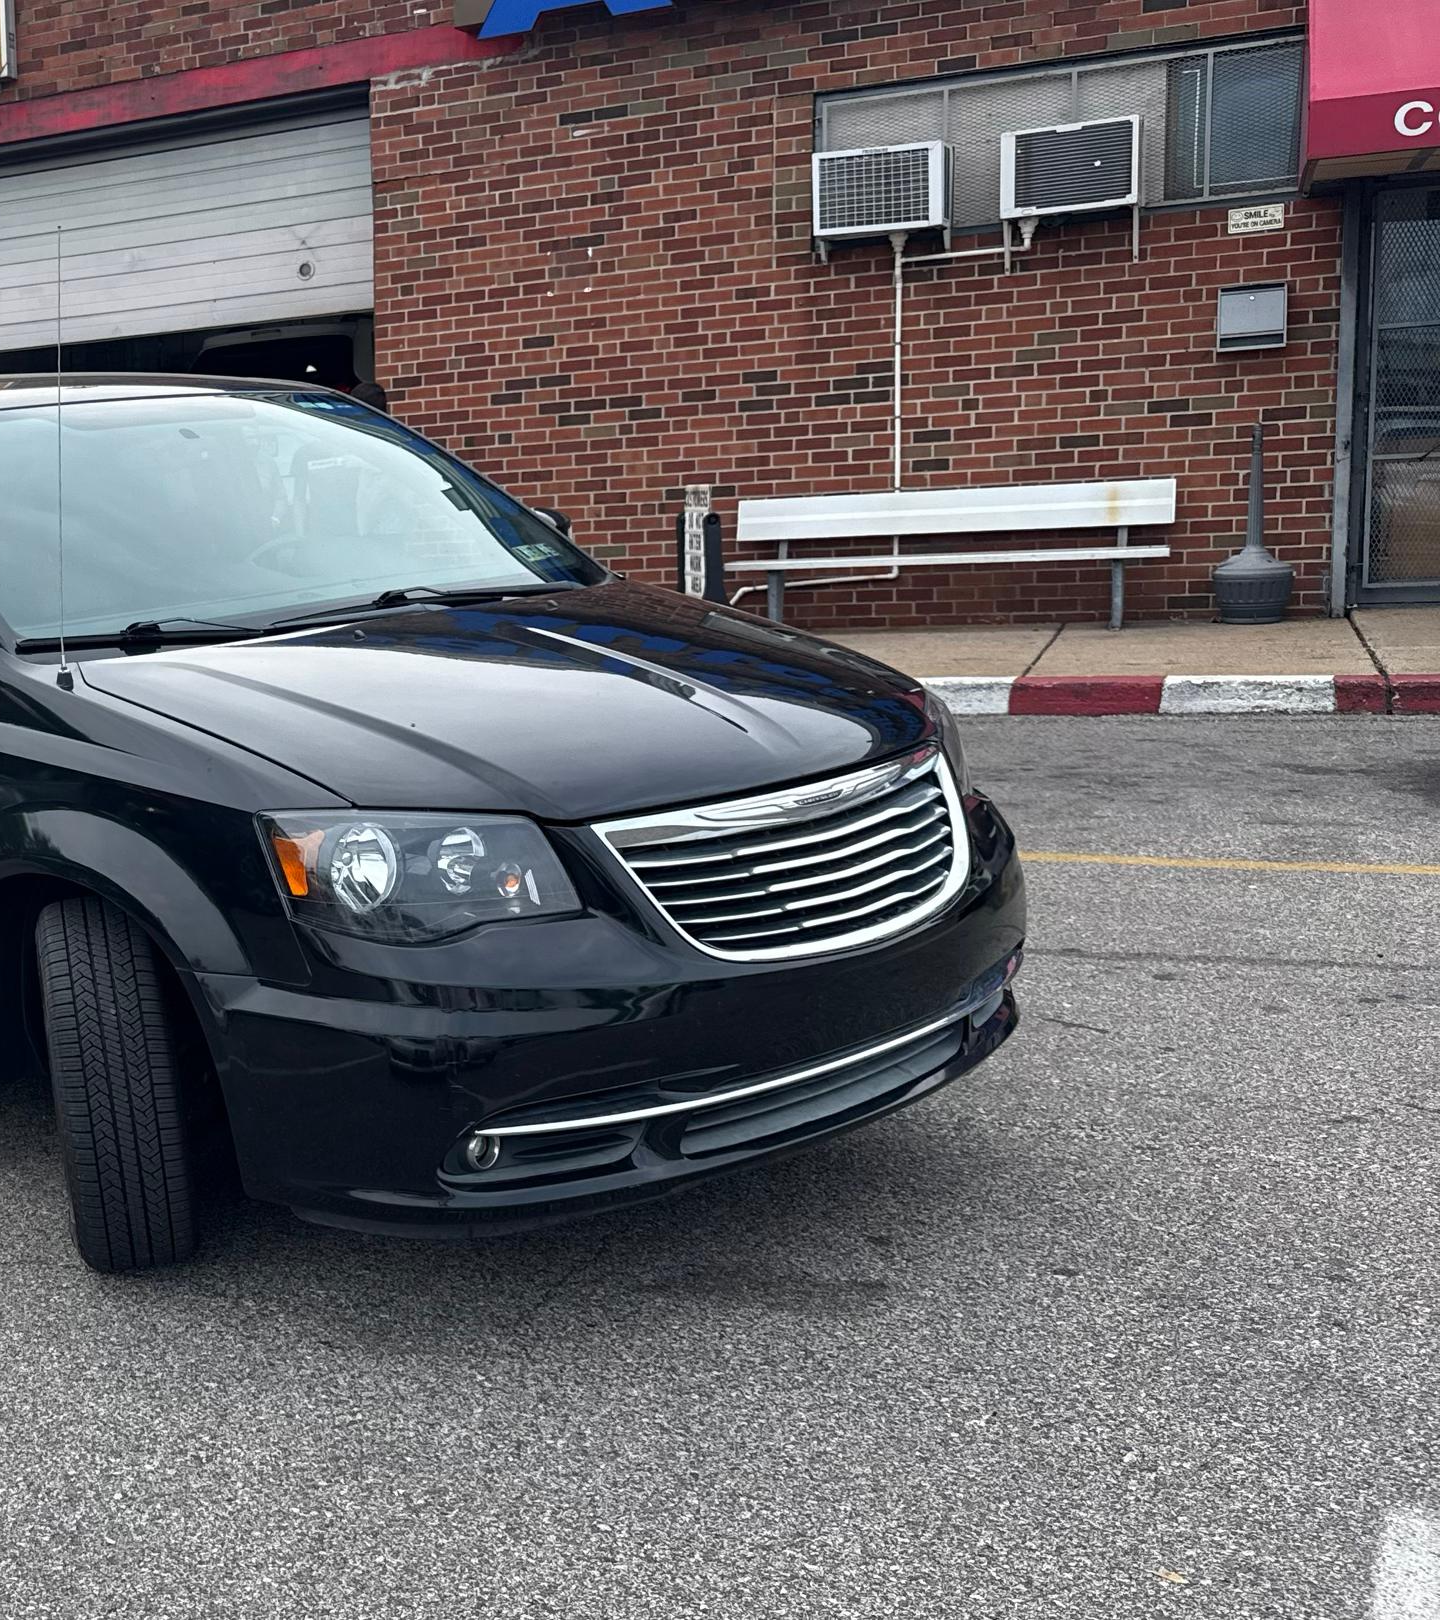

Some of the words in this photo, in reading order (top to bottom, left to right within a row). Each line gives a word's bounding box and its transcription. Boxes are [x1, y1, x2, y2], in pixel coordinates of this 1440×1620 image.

[1244, 210, 1268, 219] SMILE
[1250, 220, 1259, 228] ON
[1259, 218, 1281, 227] CAMERA
